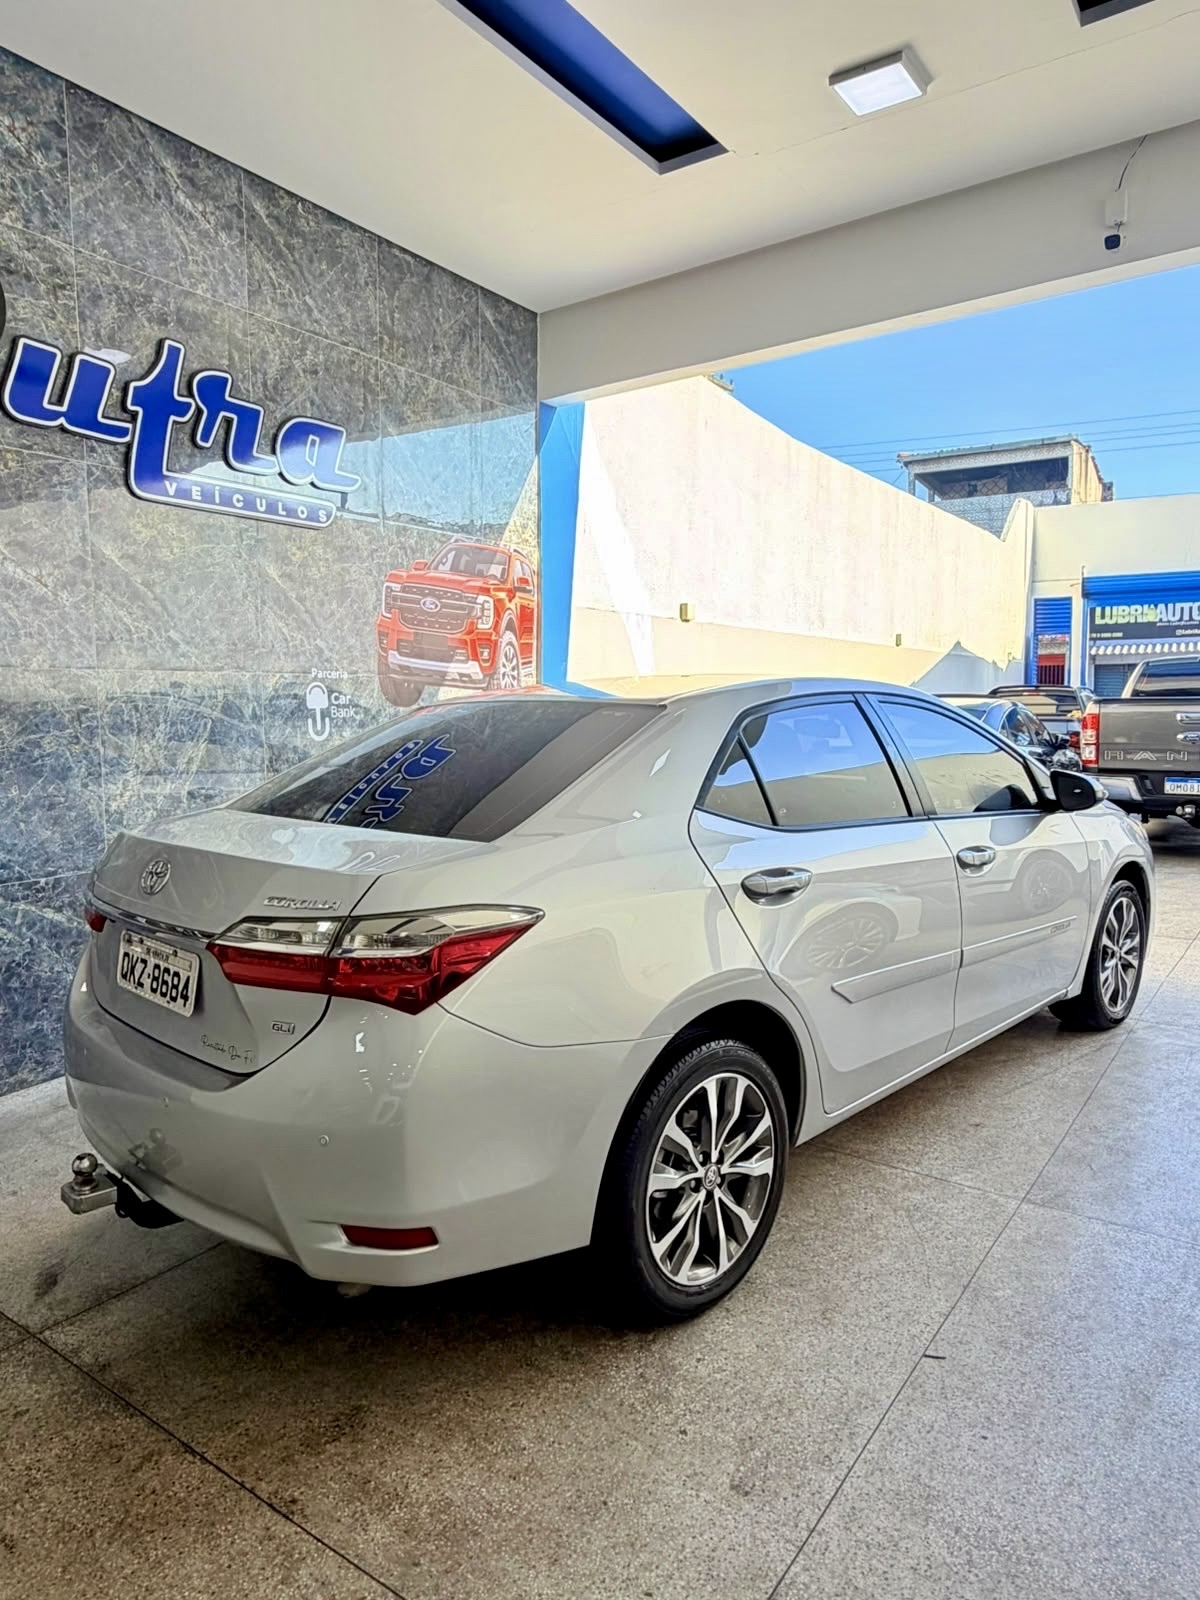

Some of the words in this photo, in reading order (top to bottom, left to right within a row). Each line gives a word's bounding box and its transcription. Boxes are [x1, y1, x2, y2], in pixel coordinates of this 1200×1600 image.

[164, 480, 328, 523] VEÍCULOS
[311, 667, 348, 679] Parceria
[331, 692, 351, 705] Car
[331, 705, 356, 718] Bank
[121, 951, 190, 1008] QKZ-8684
